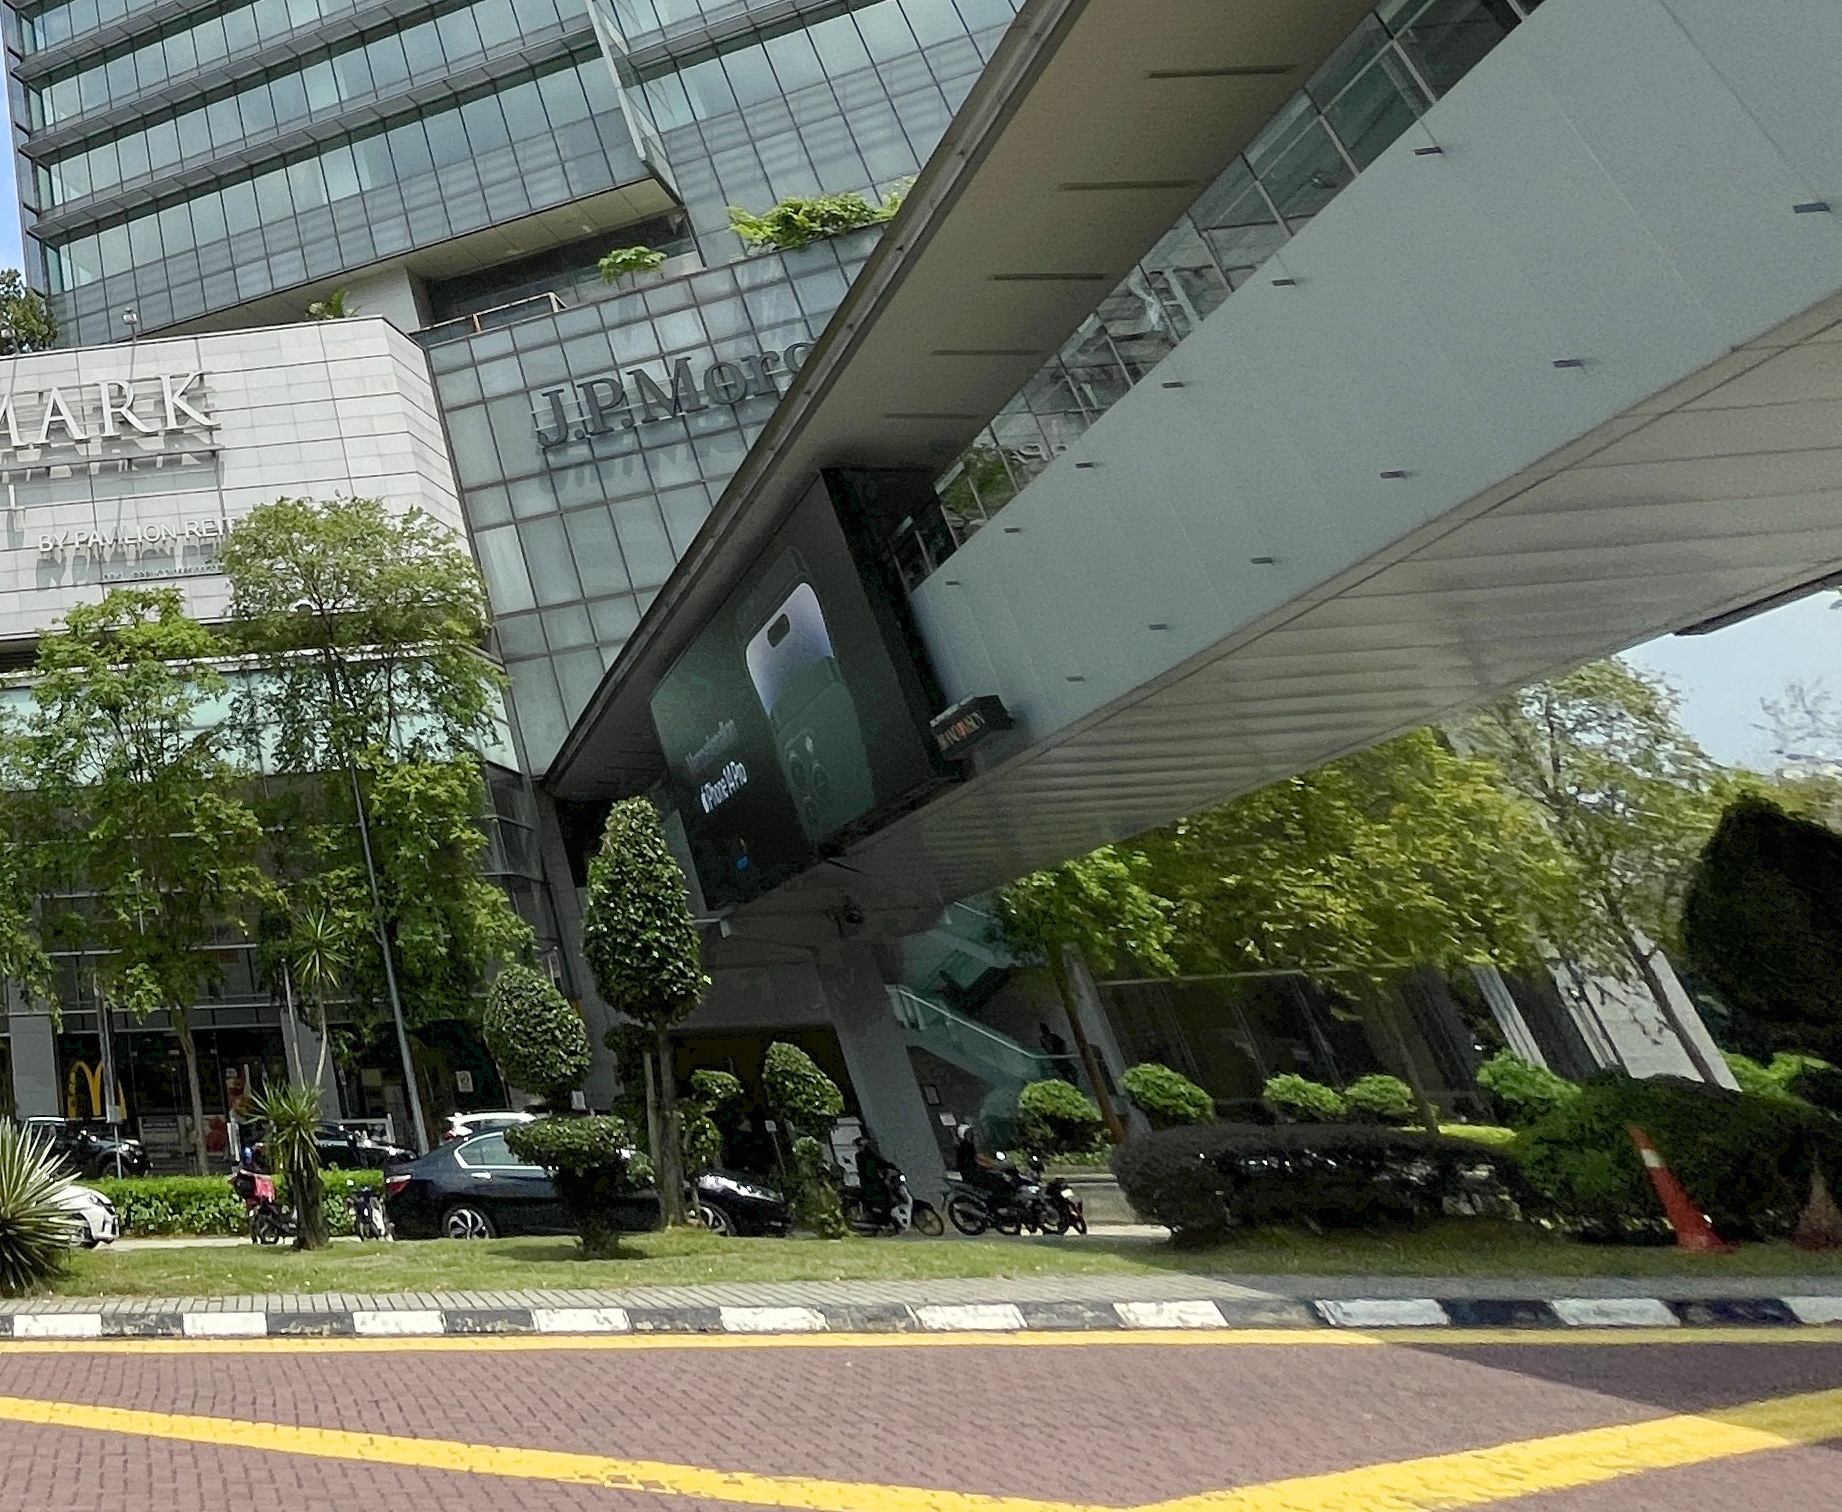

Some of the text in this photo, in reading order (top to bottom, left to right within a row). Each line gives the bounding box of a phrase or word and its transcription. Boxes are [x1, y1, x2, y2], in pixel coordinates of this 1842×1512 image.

[39, 516, 237, 552] BY PAVILION REIT
